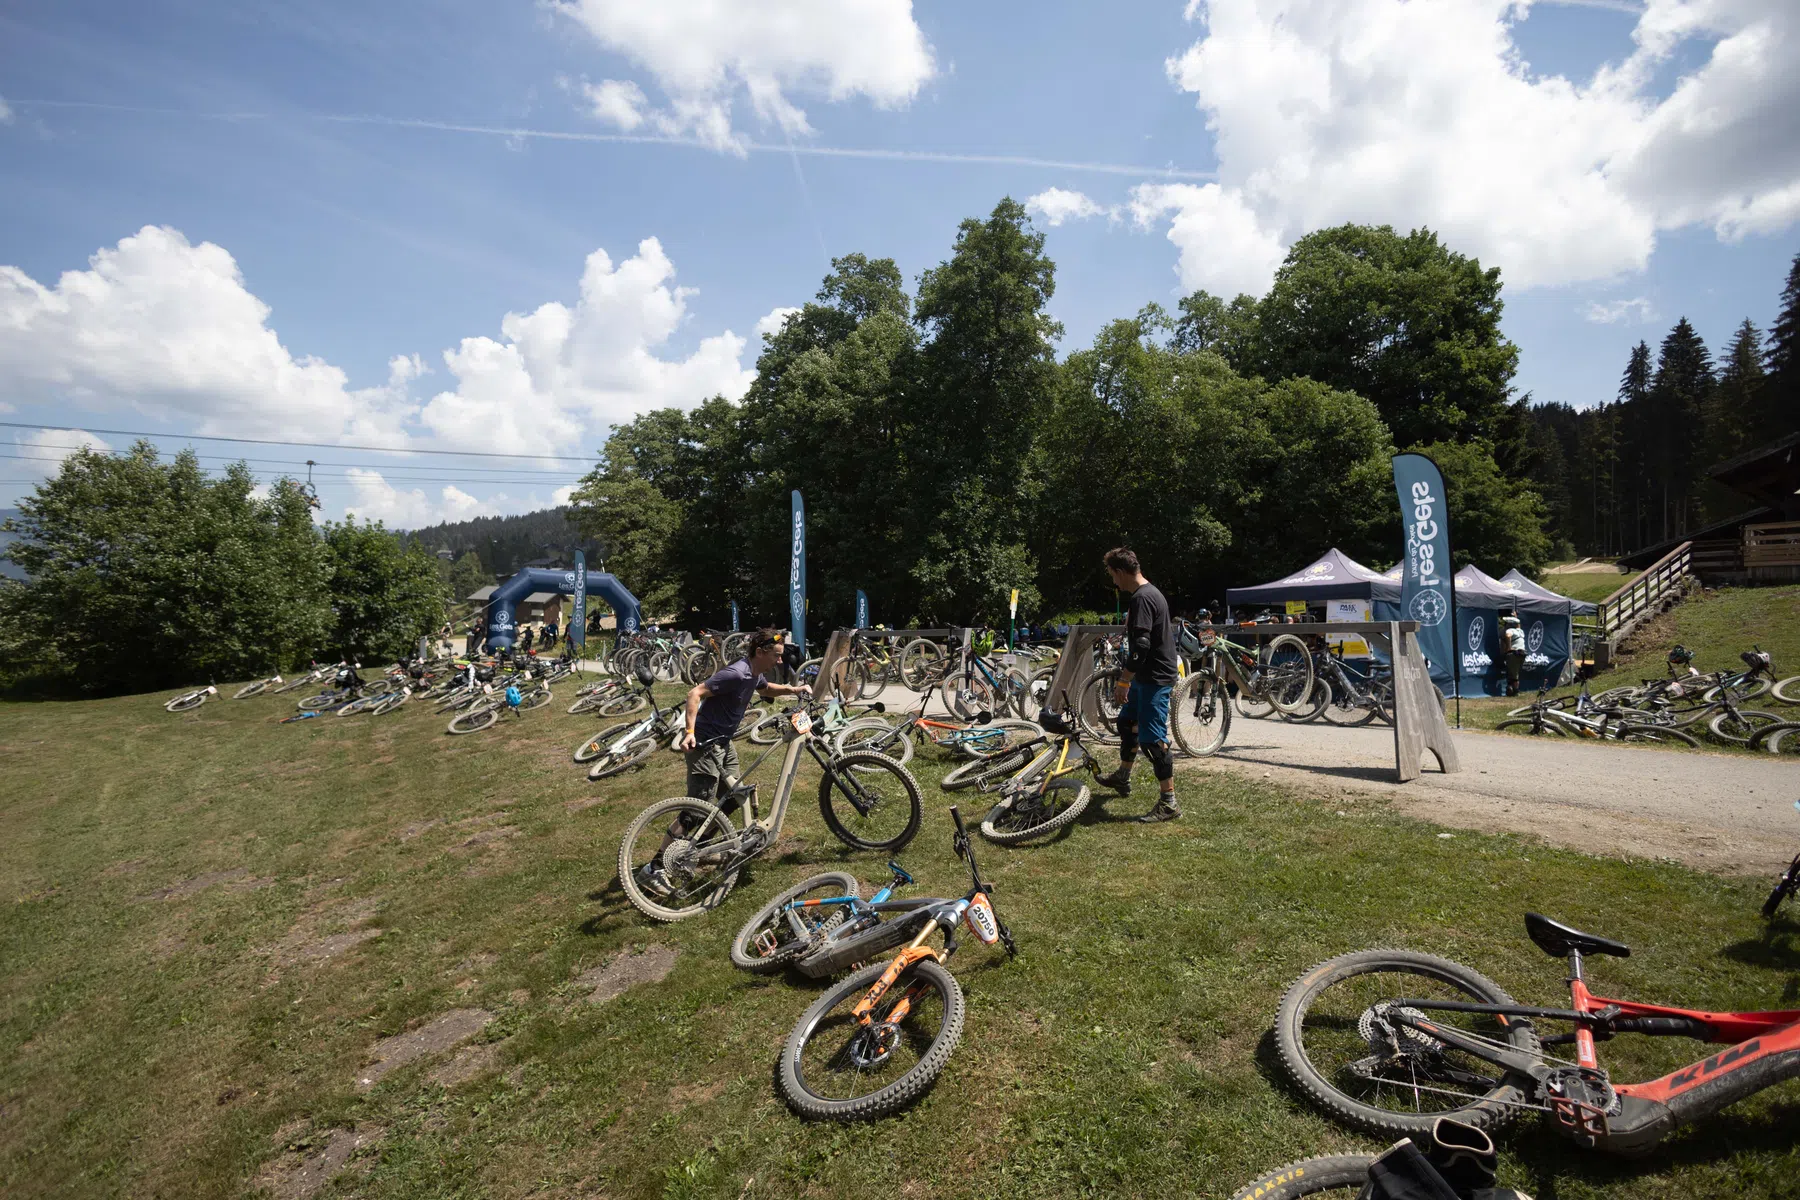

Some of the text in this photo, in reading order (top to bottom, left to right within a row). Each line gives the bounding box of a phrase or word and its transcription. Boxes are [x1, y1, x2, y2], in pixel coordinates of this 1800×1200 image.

[1462, 651, 1474, 667] Les
[973, 906, 995, 936] 20750
[863, 978, 888, 1006] FOX
[1669, 1039, 1761, 1090] KTM
[1241, 1167, 1305, 1200] MAXXIS
